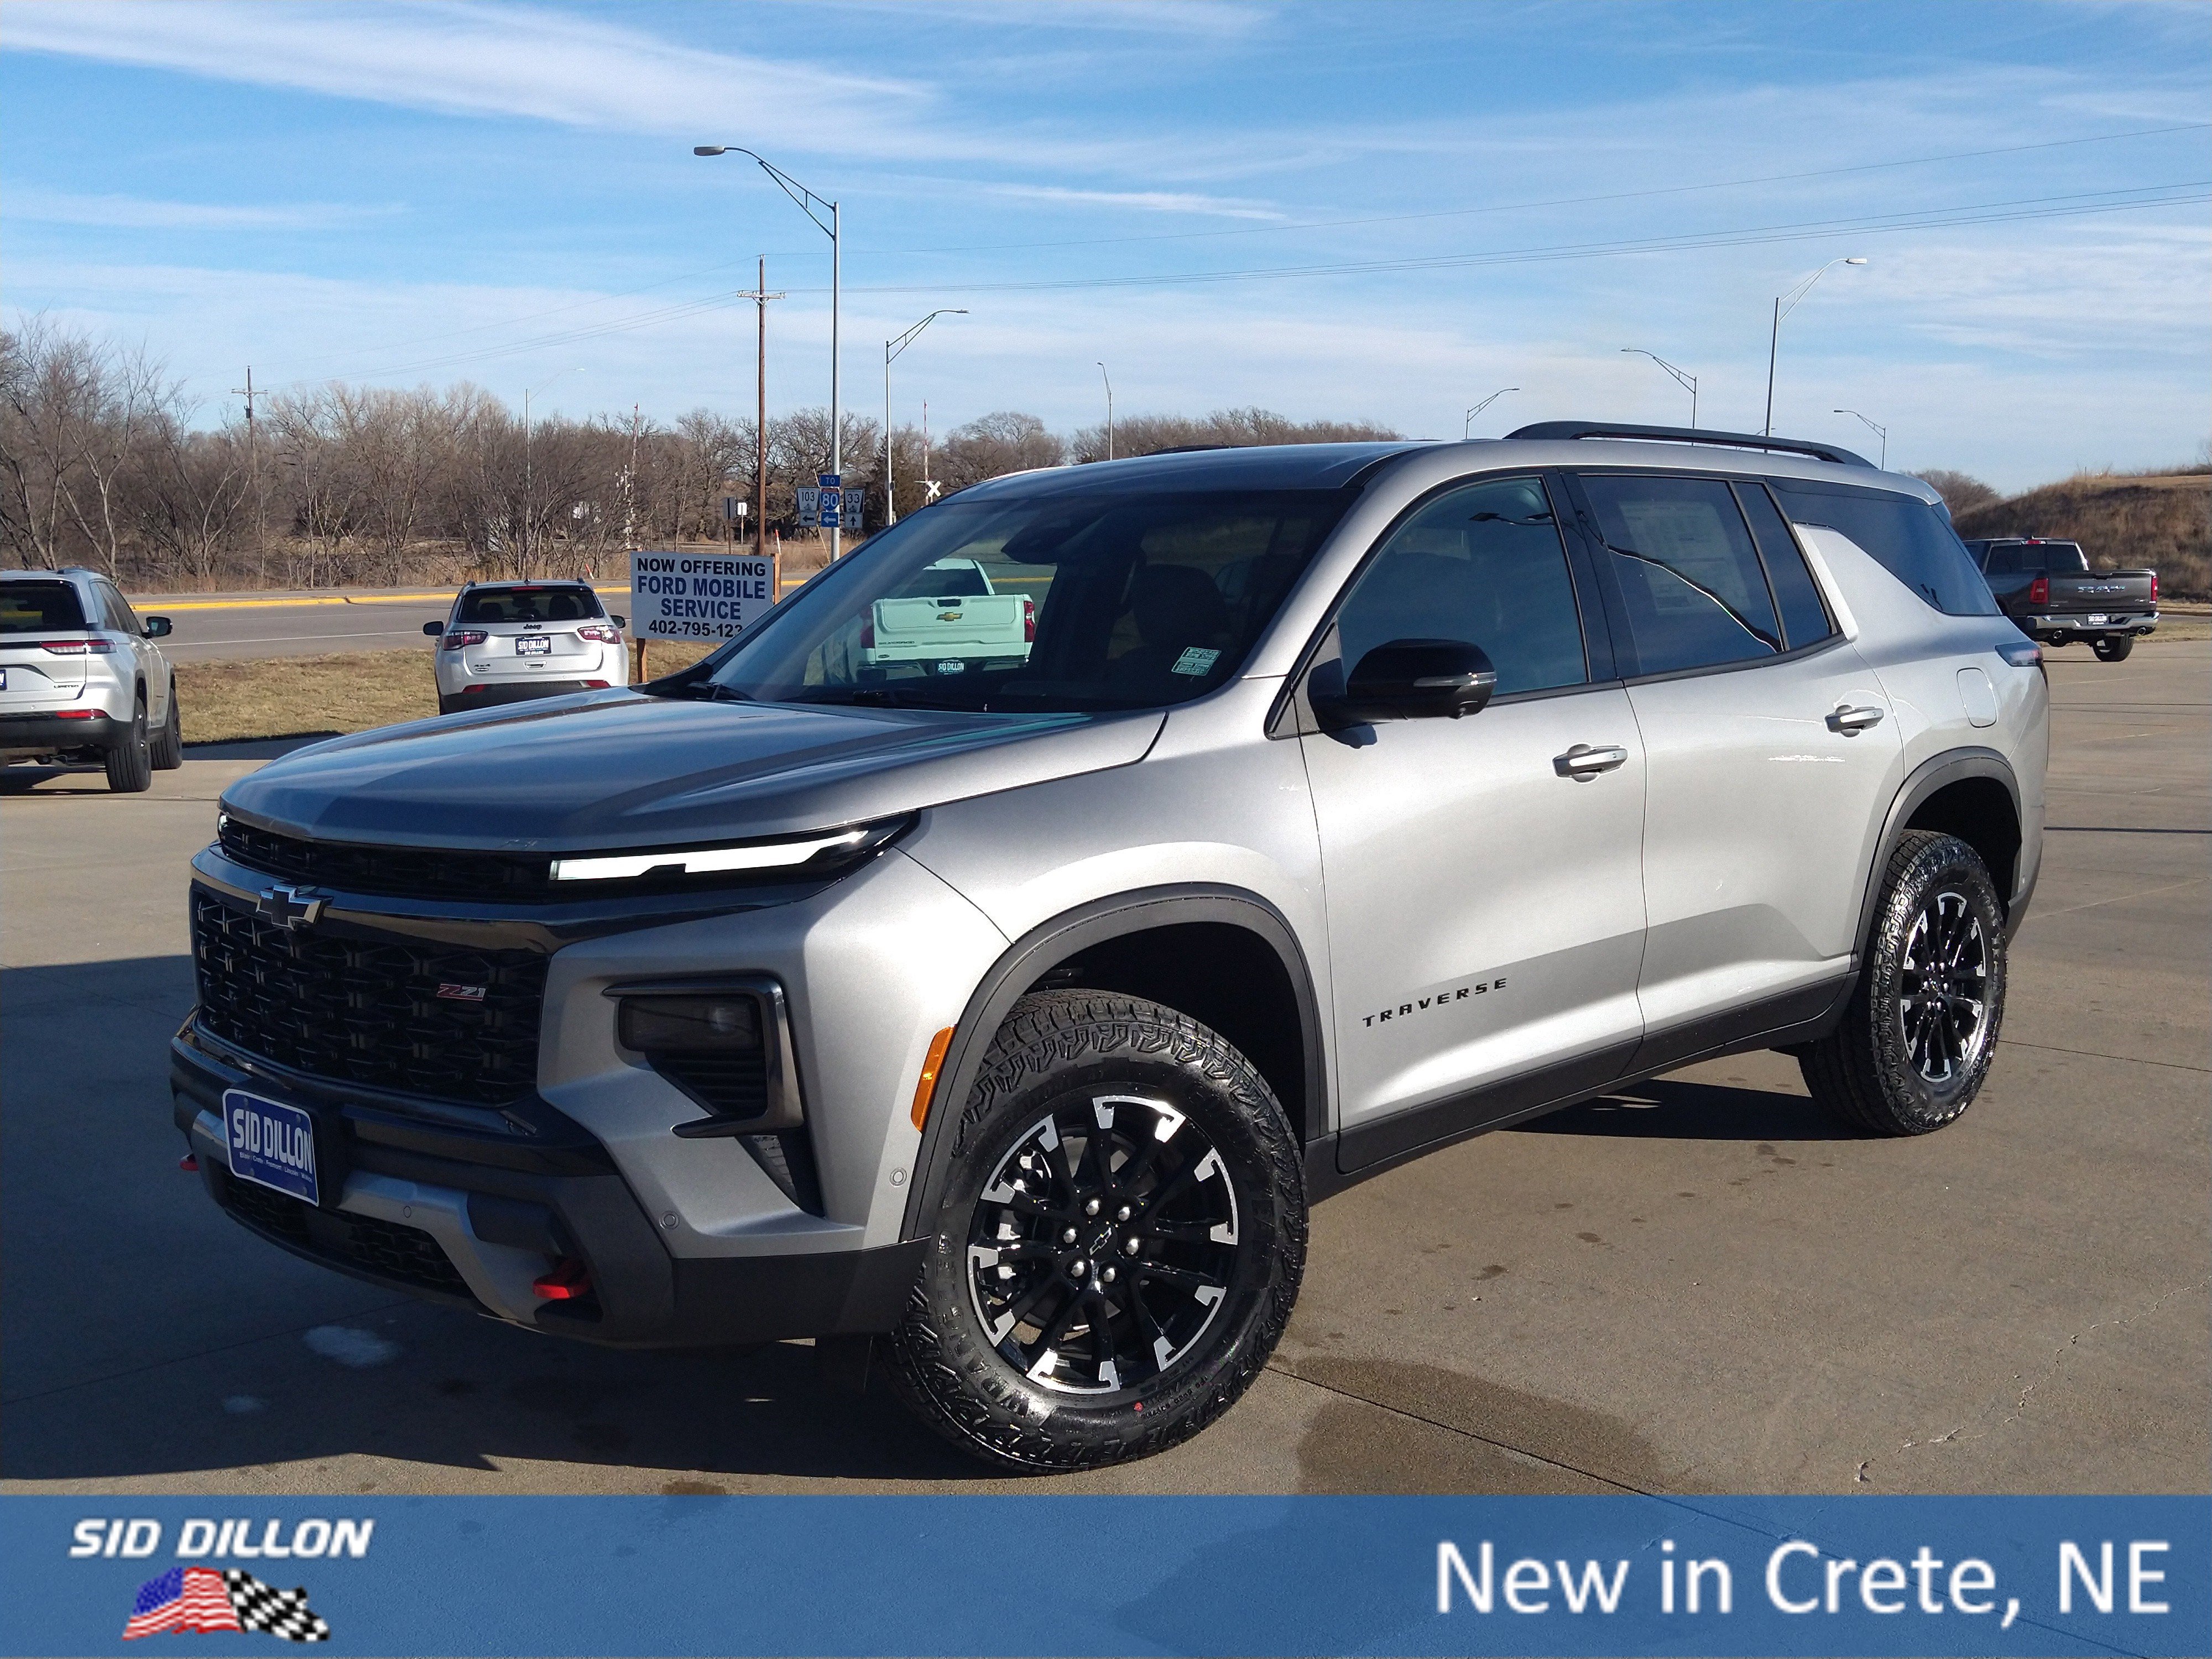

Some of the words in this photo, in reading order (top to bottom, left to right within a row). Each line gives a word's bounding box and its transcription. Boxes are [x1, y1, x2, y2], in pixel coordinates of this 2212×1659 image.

[802, 491, 815, 502] 103
[822, 493, 838, 507] 80
[847, 493, 860, 503] 33
[637, 557, 675, 573] NOW
[680, 560, 766, 577] OFFERING
[638, 575, 687, 595] FORD
[693, 578, 766, 599] MOBILE
[661, 598, 742, 620] SERVICE
[518, 641, 528, 650] SID
[528, 639, 549, 650] DILLON
[437, 984, 486, 1001] Z71
[1362, 978, 1507, 1027] TRAVERSE
[232, 1108, 260, 1153] SID
[263, 1116, 312, 1175] DILLON
